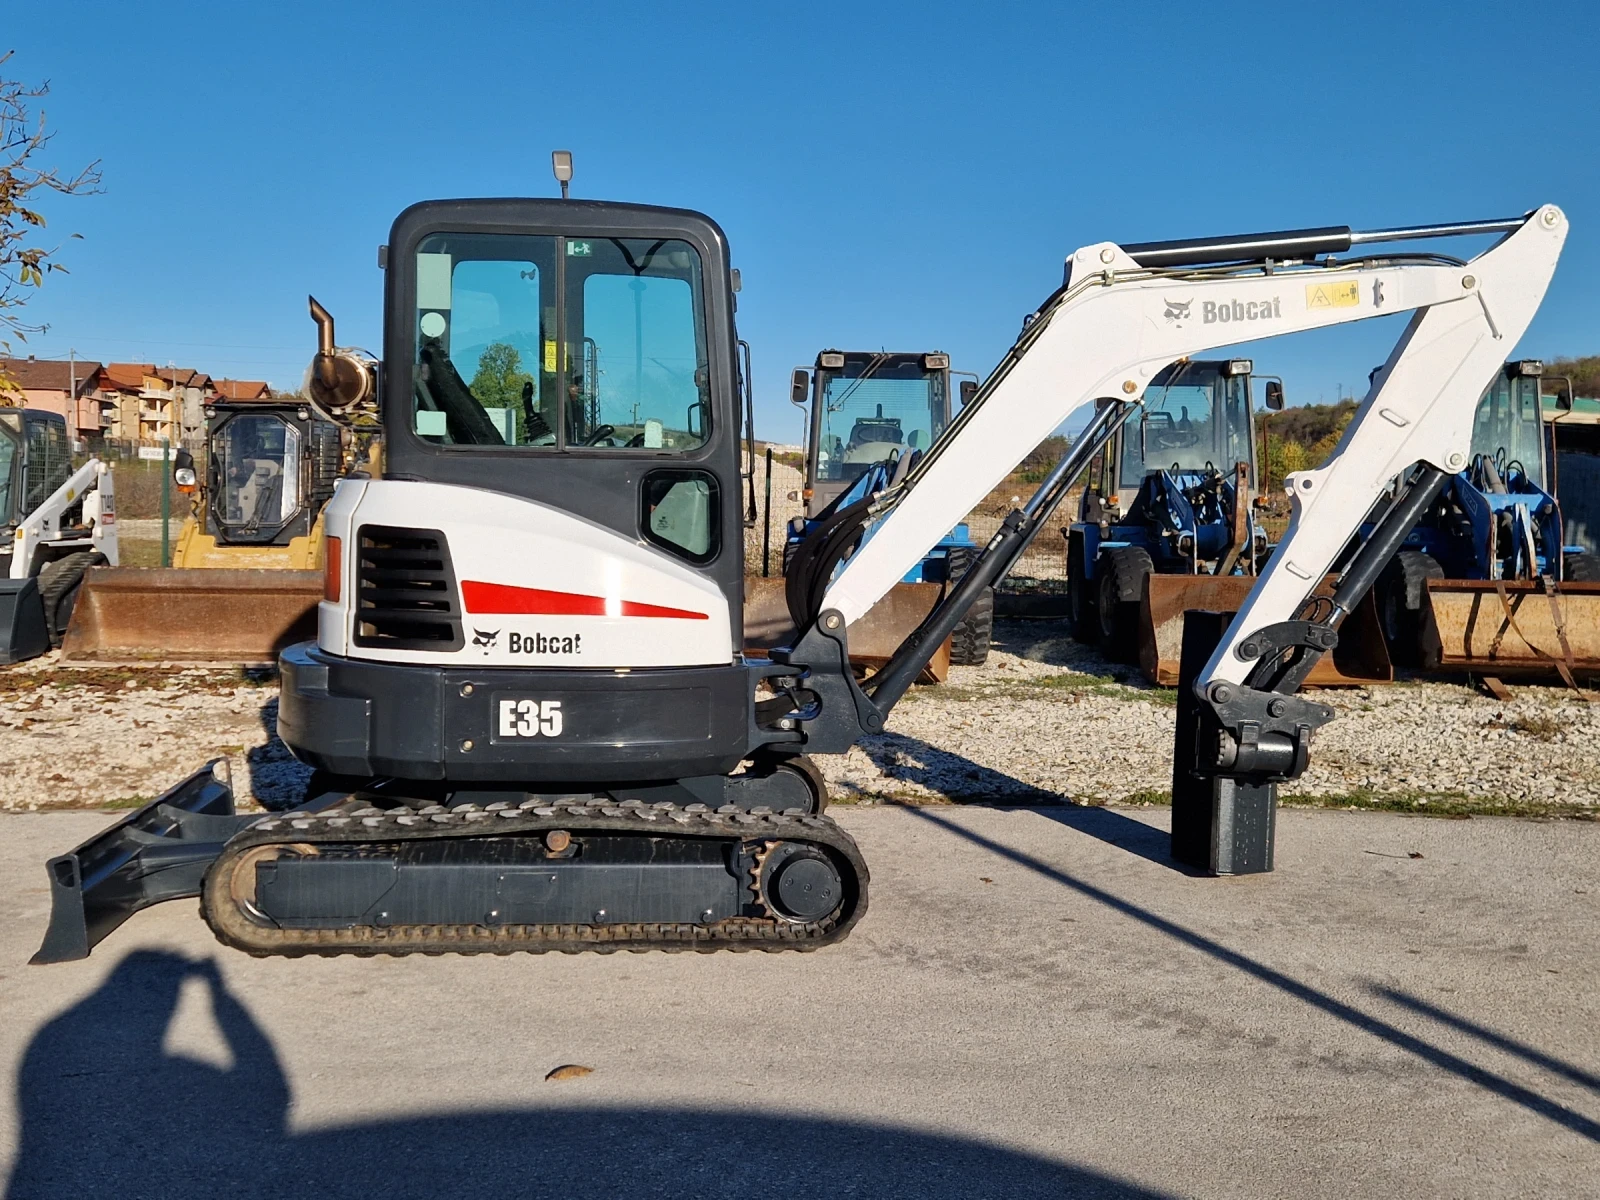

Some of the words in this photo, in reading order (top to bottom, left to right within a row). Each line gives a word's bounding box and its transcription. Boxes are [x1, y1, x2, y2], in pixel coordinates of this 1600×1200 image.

[1203, 296, 1281, 324] Bobcat
[509, 632, 581, 654] Bobcat
[499, 700, 562, 737] E35
